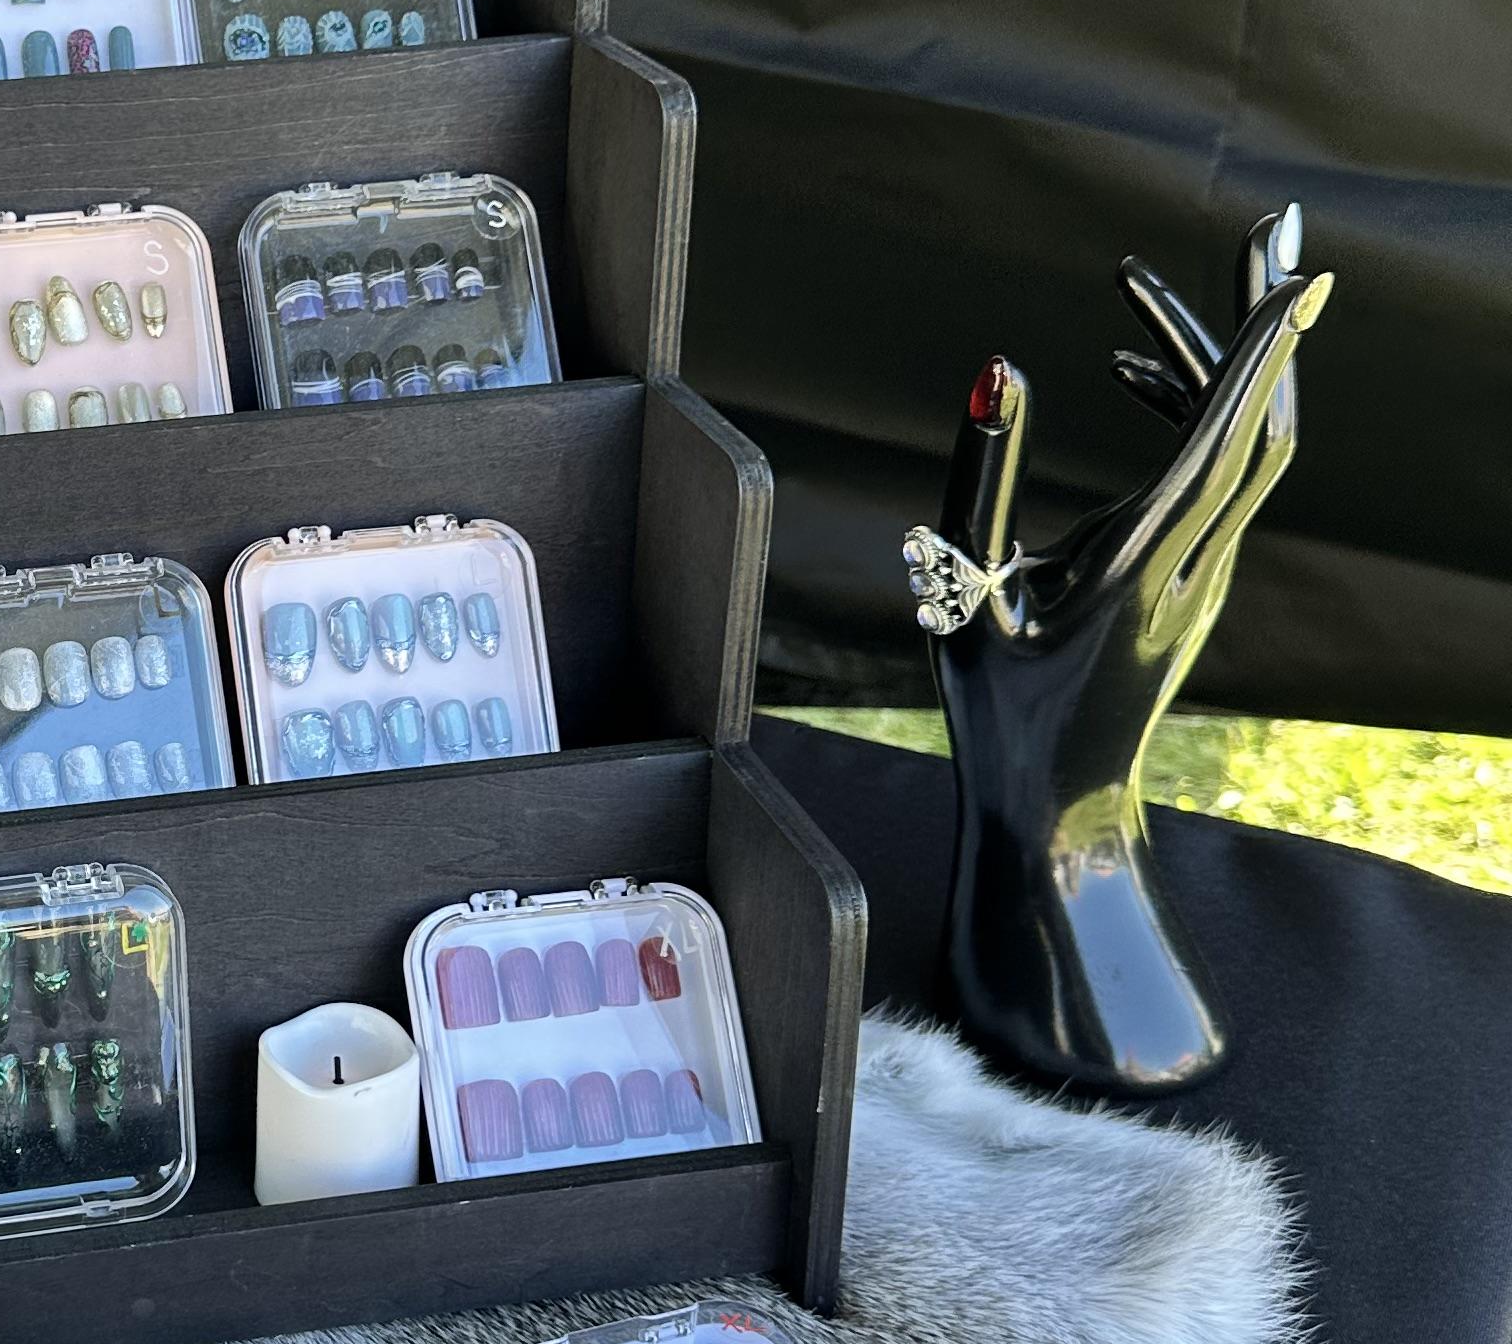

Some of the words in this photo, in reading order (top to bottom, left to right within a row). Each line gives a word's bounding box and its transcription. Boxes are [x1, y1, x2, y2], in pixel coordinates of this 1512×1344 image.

[486, 199, 508, 229] S
[143, 240, 170, 276] S
[719, 1311, 768, 1334] XL
